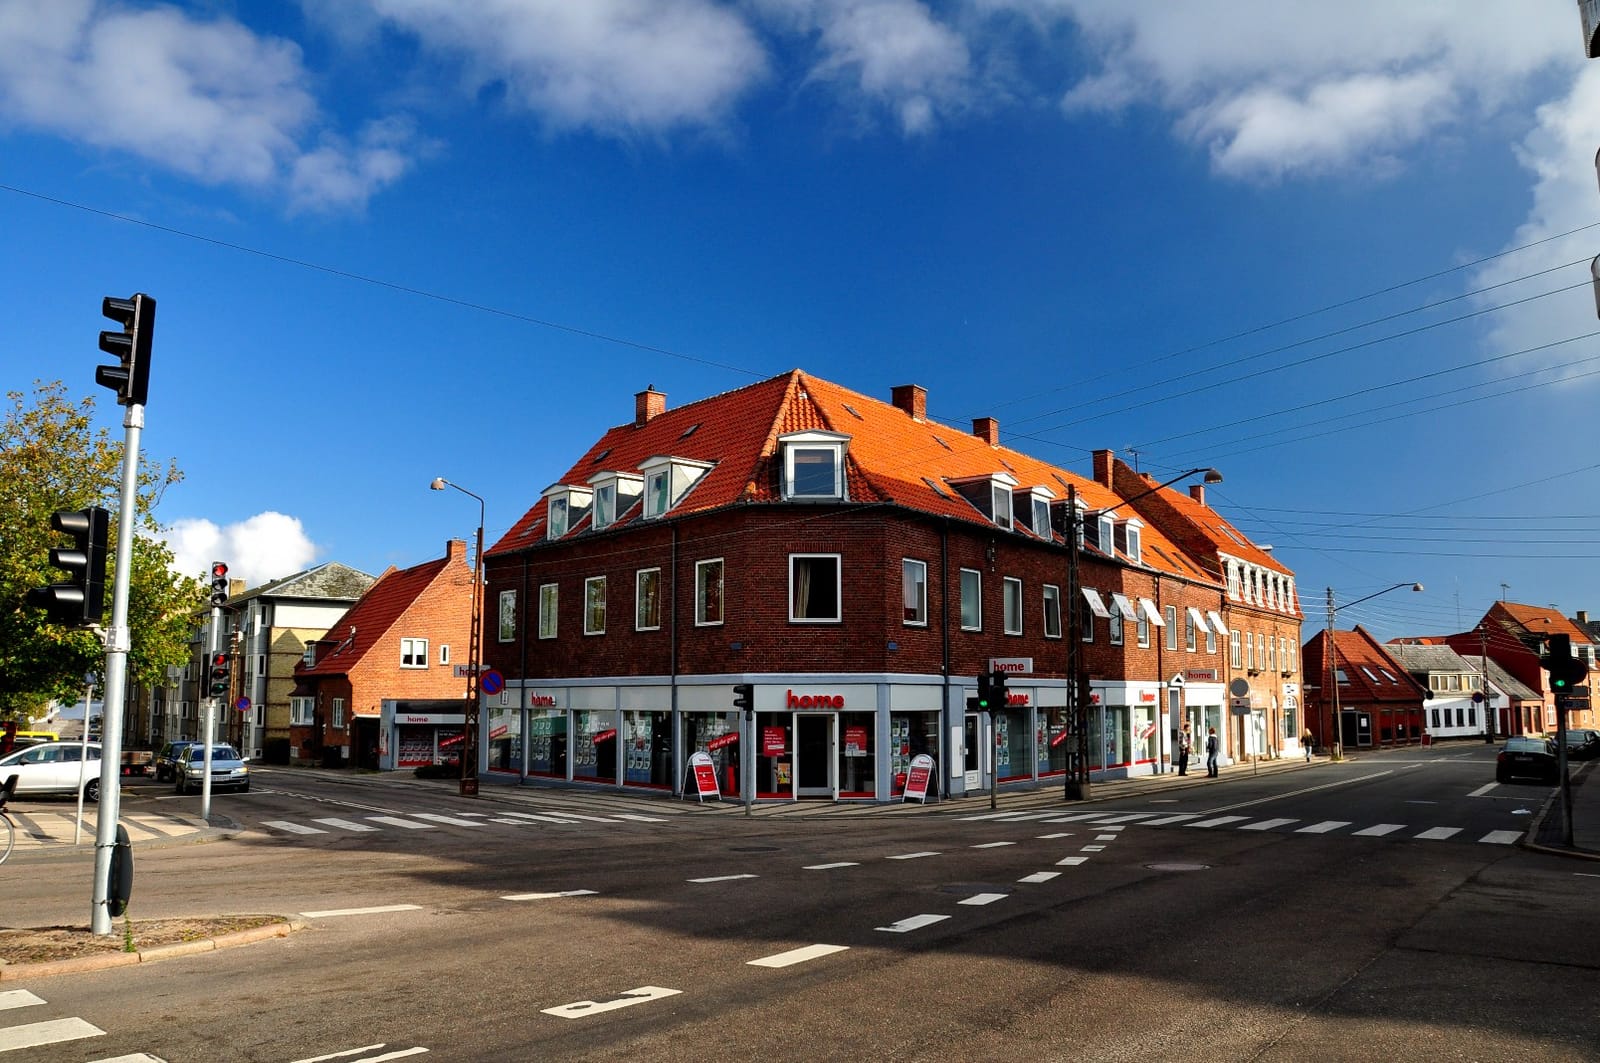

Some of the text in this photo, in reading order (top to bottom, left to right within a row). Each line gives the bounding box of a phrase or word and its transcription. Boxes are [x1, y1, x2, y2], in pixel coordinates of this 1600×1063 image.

[1188, 671, 1212, 679] home
[786, 689, 845, 709] home
[407, 715, 429, 723] home
